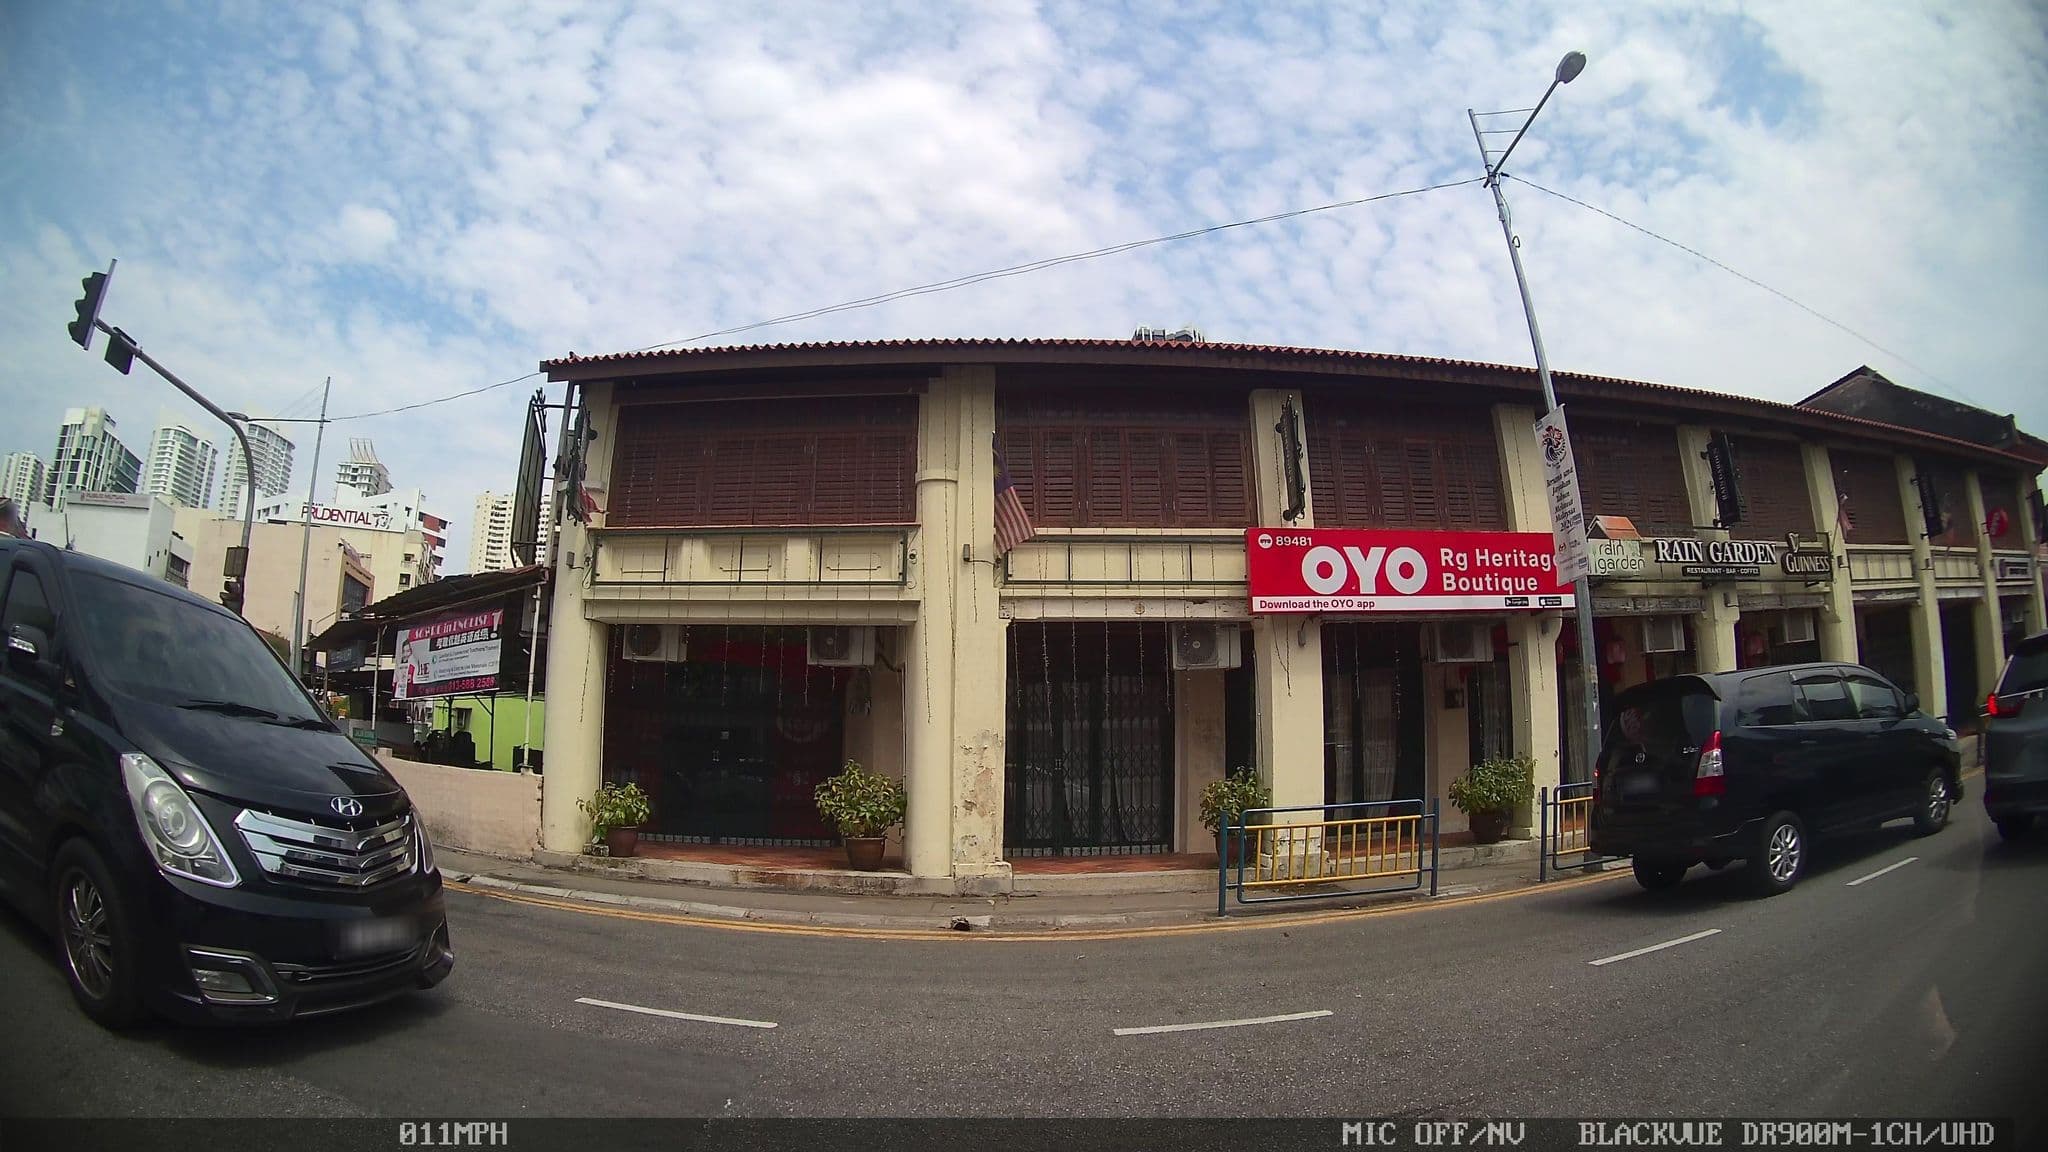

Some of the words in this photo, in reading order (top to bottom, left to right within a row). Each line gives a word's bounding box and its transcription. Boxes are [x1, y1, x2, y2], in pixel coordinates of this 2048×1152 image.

[301, 506, 371, 525] PRUDENTIAL
[1276, 536, 1312, 546] 89481
[1599, 540, 1625, 556] rain
[1440, 548, 1468, 571] Rg
[1656, 539, 1704, 562] RAIN
[1709, 541, 1777, 564] GARDEN
[1301, 546, 1428, 595] OYO
[1597, 556, 1645, 574] garden
[1785, 552, 1831, 573] GUINNESS
[1442, 573, 1538, 595] Boutique
[1259, 600, 1310, 609] Download
[1312, 600, 1329, 609] the
[1331, 599, 1354, 608] OYO
[1357, 600, 1375, 610] app
